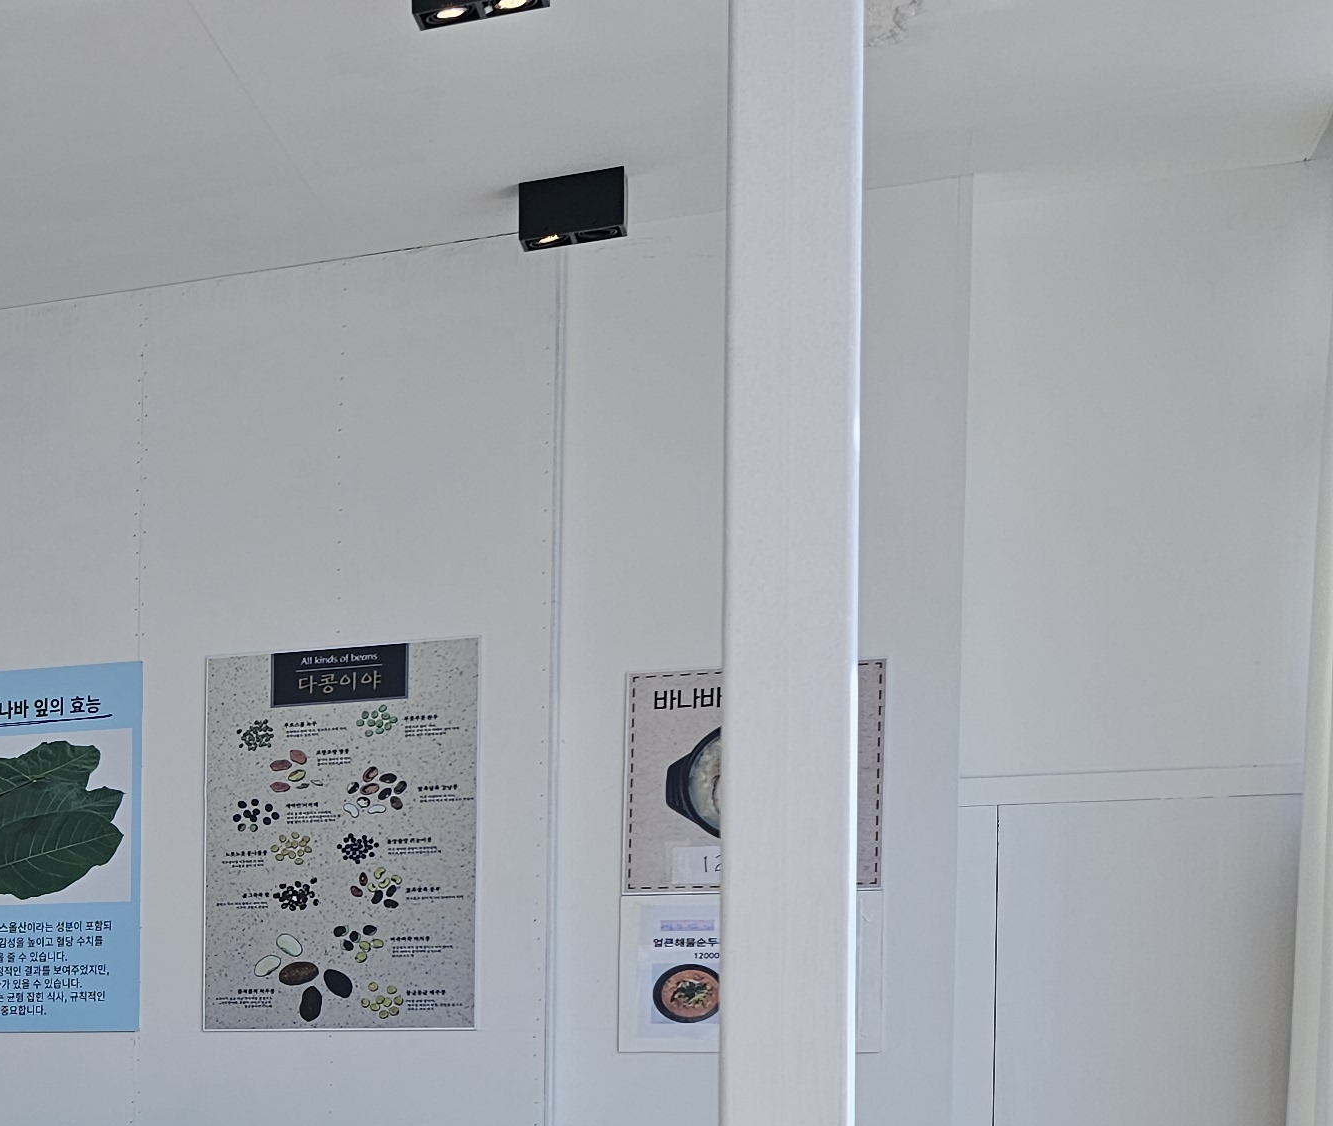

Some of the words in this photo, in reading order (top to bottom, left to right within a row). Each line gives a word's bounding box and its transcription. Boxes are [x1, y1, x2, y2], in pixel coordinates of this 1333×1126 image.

[301, 656, 312, 665] All
[315, 654, 337, 664] kinds
[340, 654, 349, 663] of
[351, 653, 378, 662] beans
[298, 670, 382, 695] 다콩이야
[34, 698, 64, 717] 잎의
[70, 696, 101, 713] 효능
[56, 921, 82, 932] 성분이
[85, 920, 112, 931] 포함되
[27, 937, 53, 948] 높이고
[77, 935, 103, 947] 수치를
[653, 937, 721, 947] 얼큰해물순두
[18, 951, 27, 962] 수
[30, 951, 68, 963] 있습니다.
[24, 965, 50, 976] 결과를
[53, 964, 110, 976] 보여주었지만,
[13, 979, 30, 989] 있을
[33, 978, 42, 989] 수
[45, 978, 82, 989] 있습니다.
[47, 991, 67, 1003] 식사,
[70, 991, 106, 1002] 규칙적인
[1, 1004, 47, 1016] 중요합니다.
